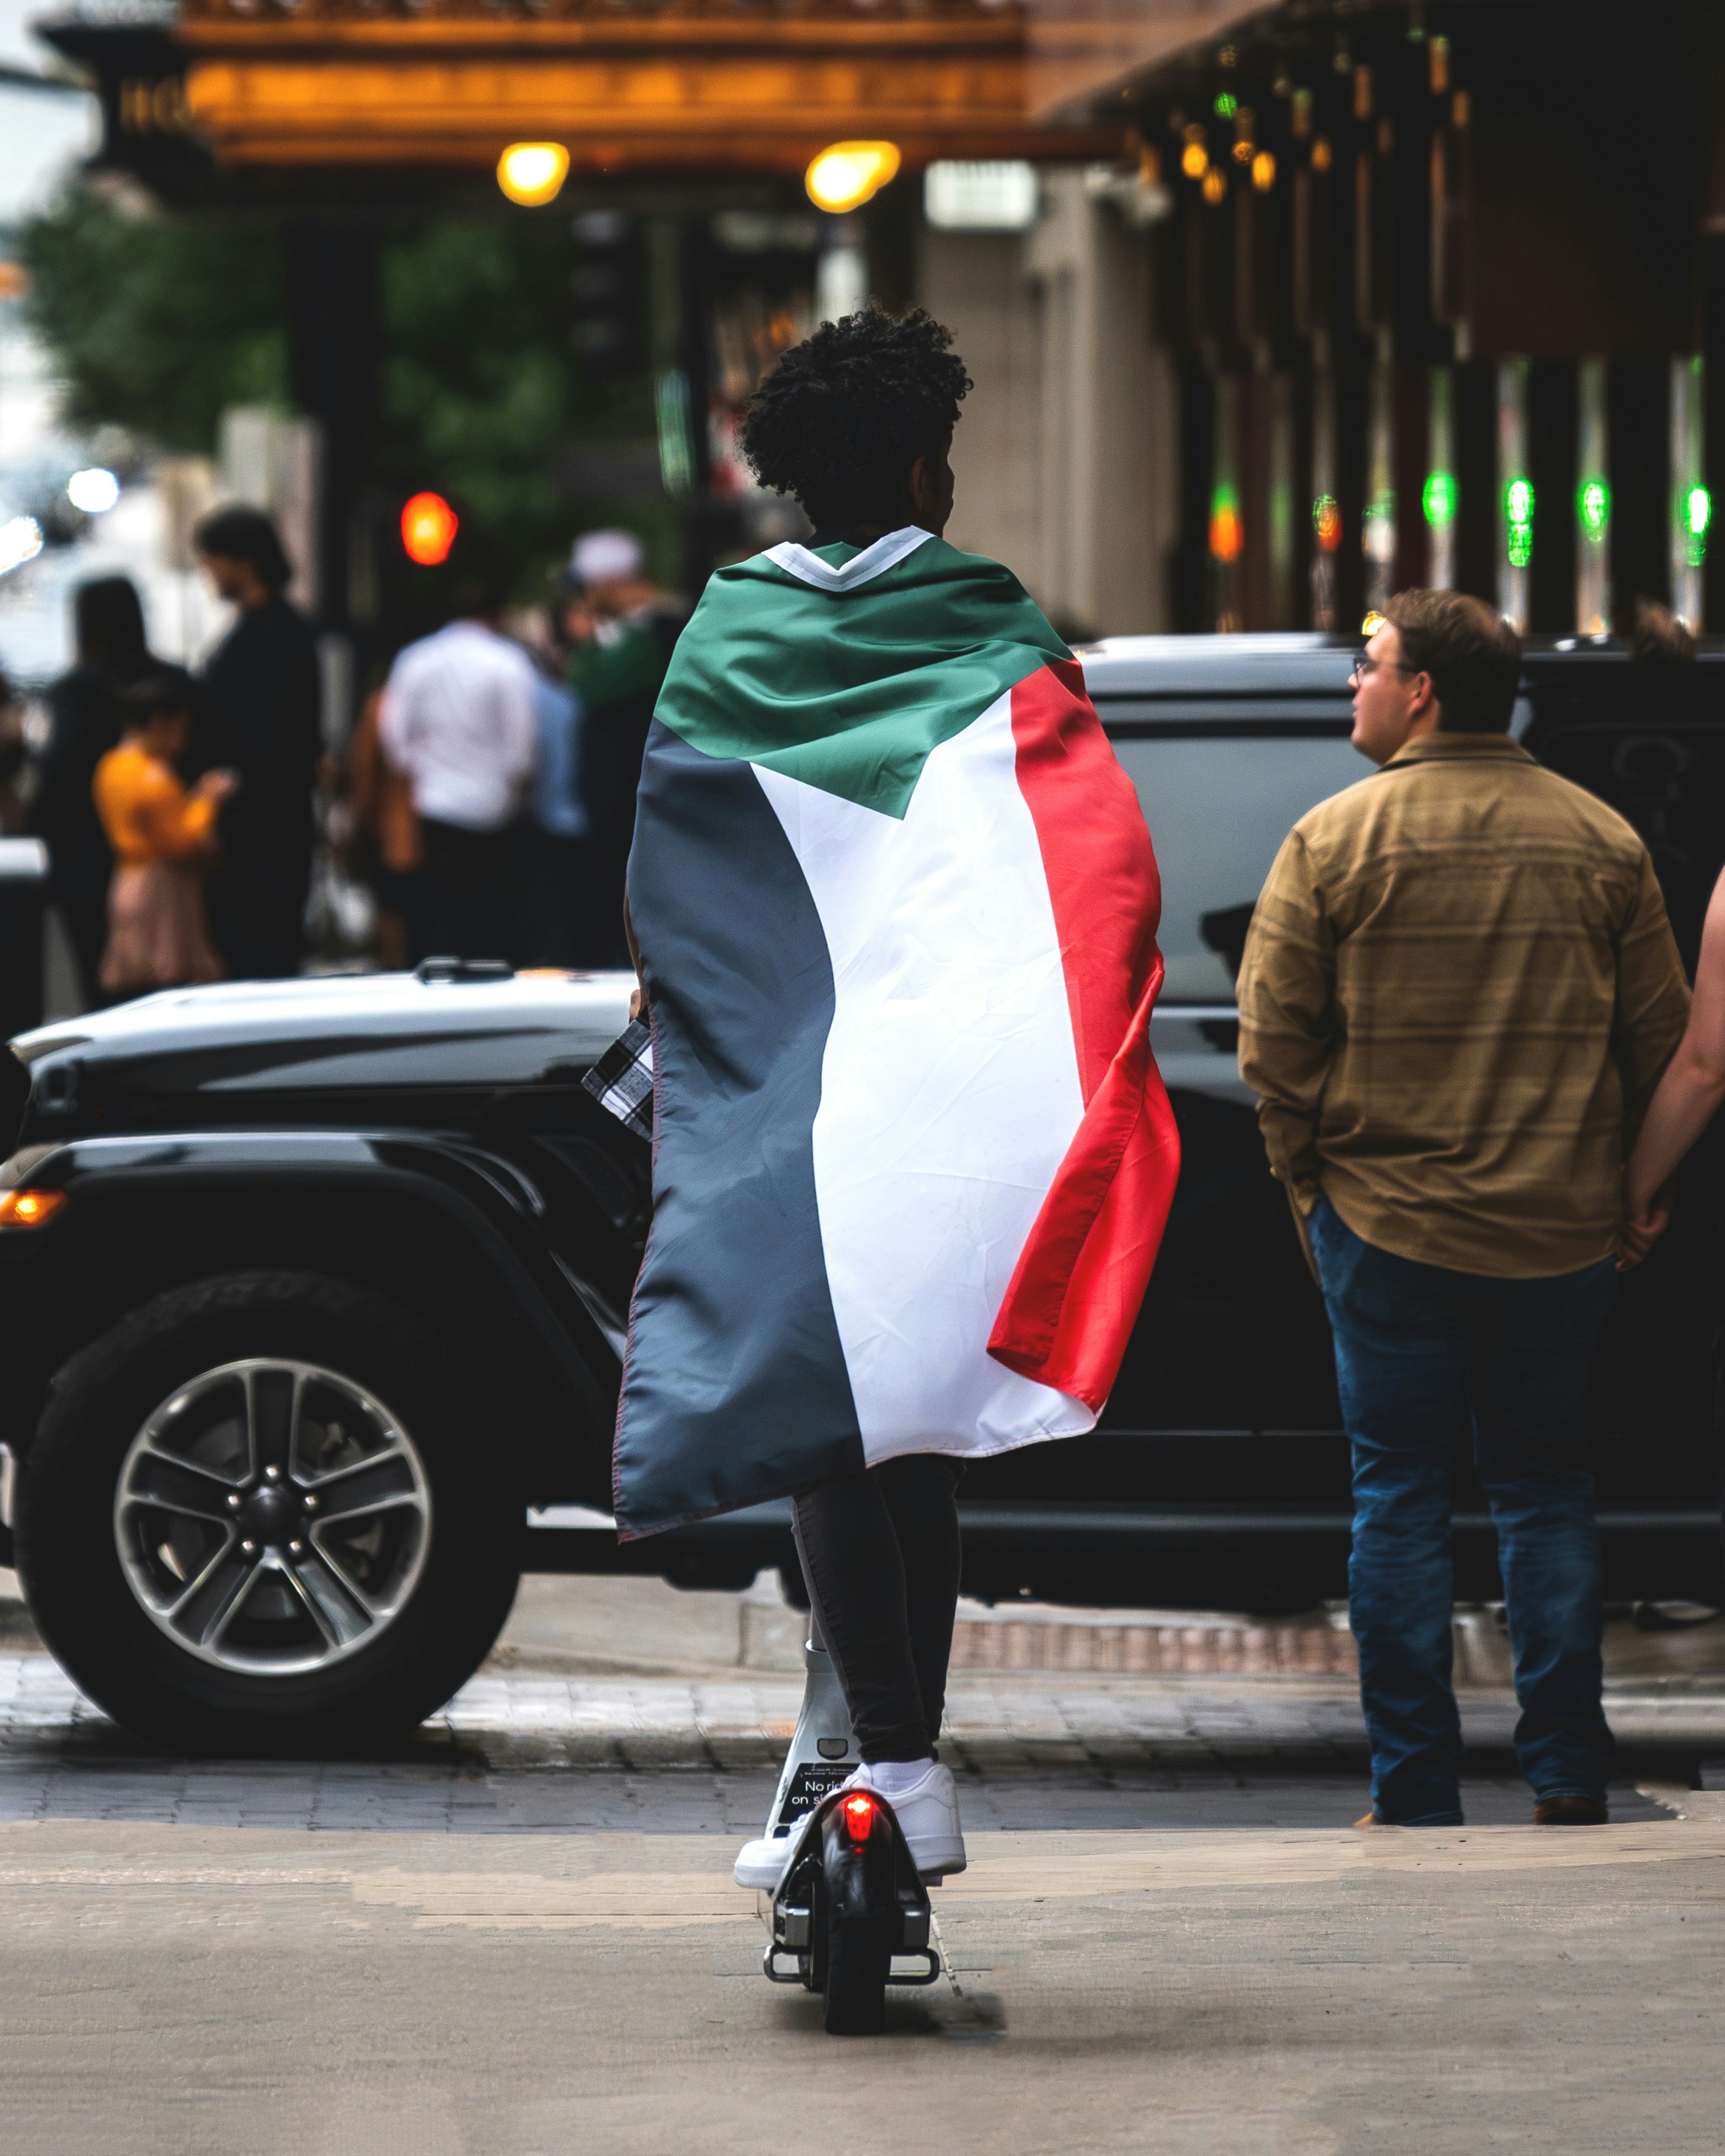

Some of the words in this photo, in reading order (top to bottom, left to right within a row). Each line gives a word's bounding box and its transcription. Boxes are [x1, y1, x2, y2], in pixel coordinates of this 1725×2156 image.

[805, 1781, 824, 1792] No
[826, 1780, 843, 1792] rid
[791, 1796, 808, 1805] on
